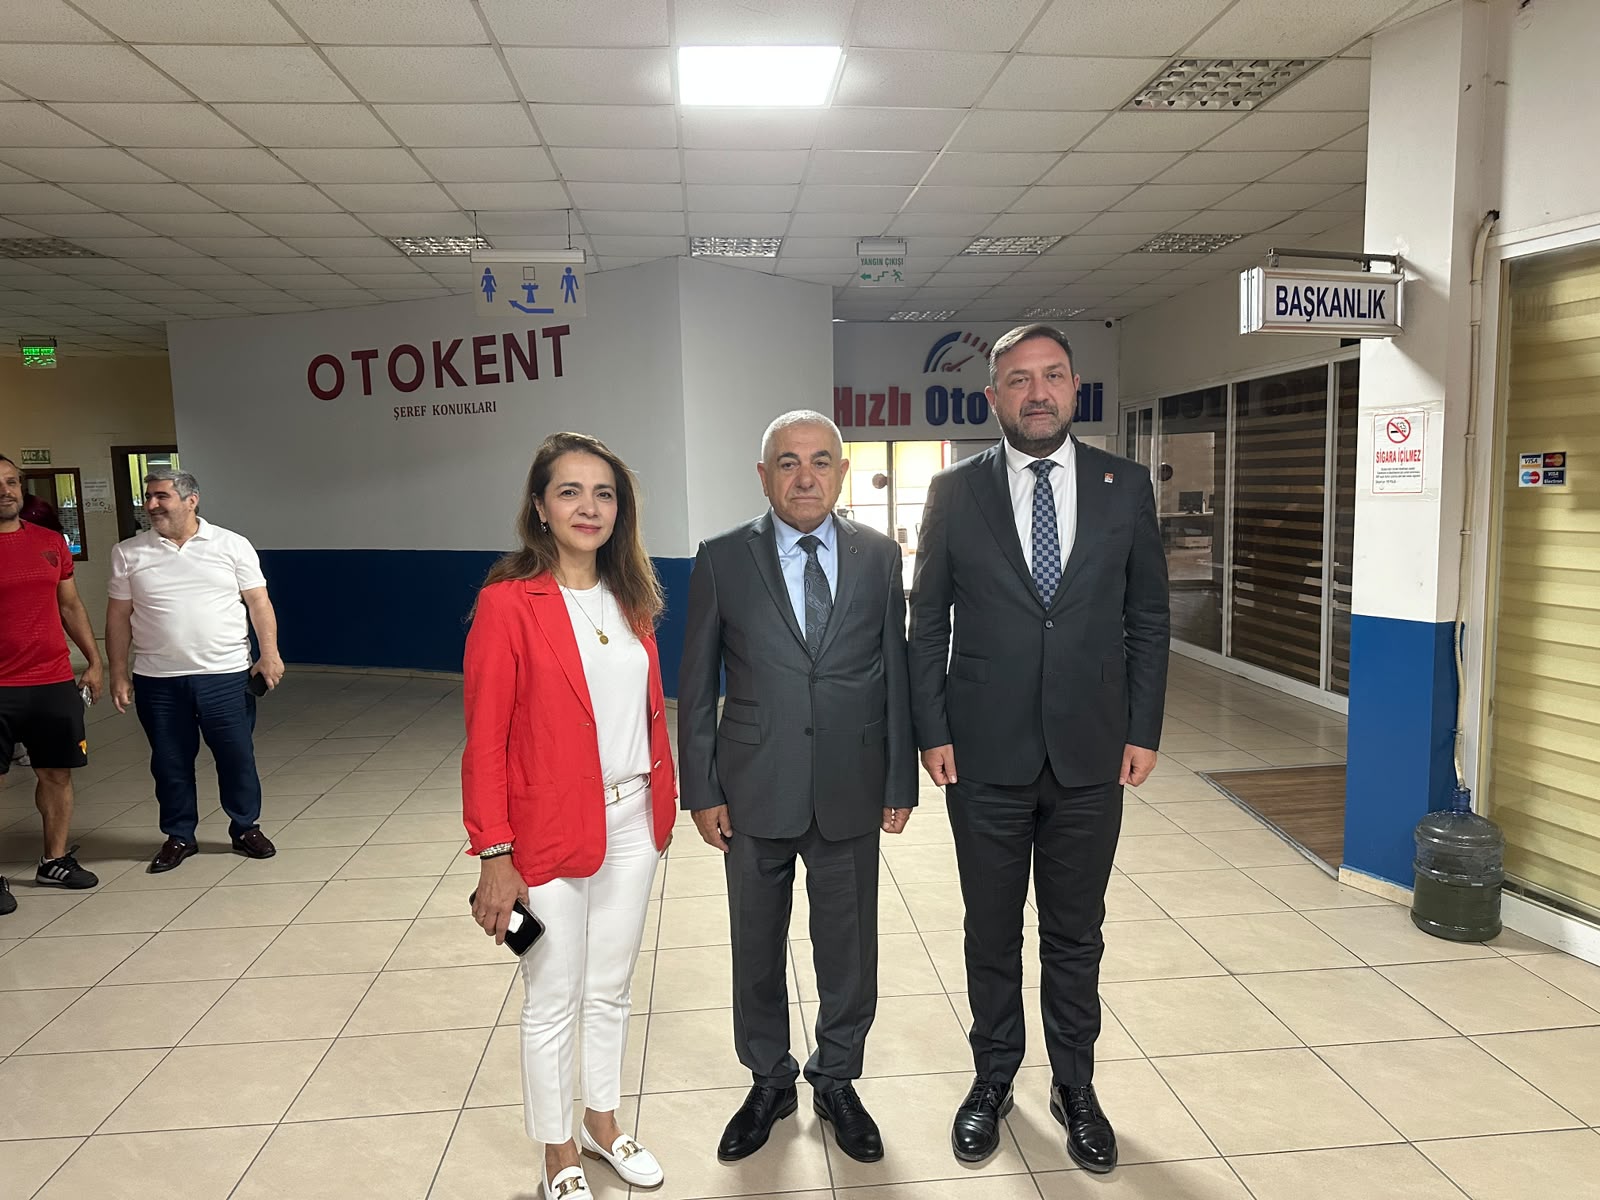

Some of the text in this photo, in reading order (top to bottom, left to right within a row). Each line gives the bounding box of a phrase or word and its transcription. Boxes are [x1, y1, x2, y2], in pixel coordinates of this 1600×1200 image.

[860, 257, 883, 266] YANGIN
[1275, 285, 1386, 322] BAŞKANLIK
[307, 324, 570, 401] OTOKENT
[393, 401, 496, 421] ŞEREF KONUKLARI
[925, 385, 988, 426] Oto
[22, 451, 36, 460] WC
[1376, 447, 1421, 466] SİGARA İÇİLMEZ
